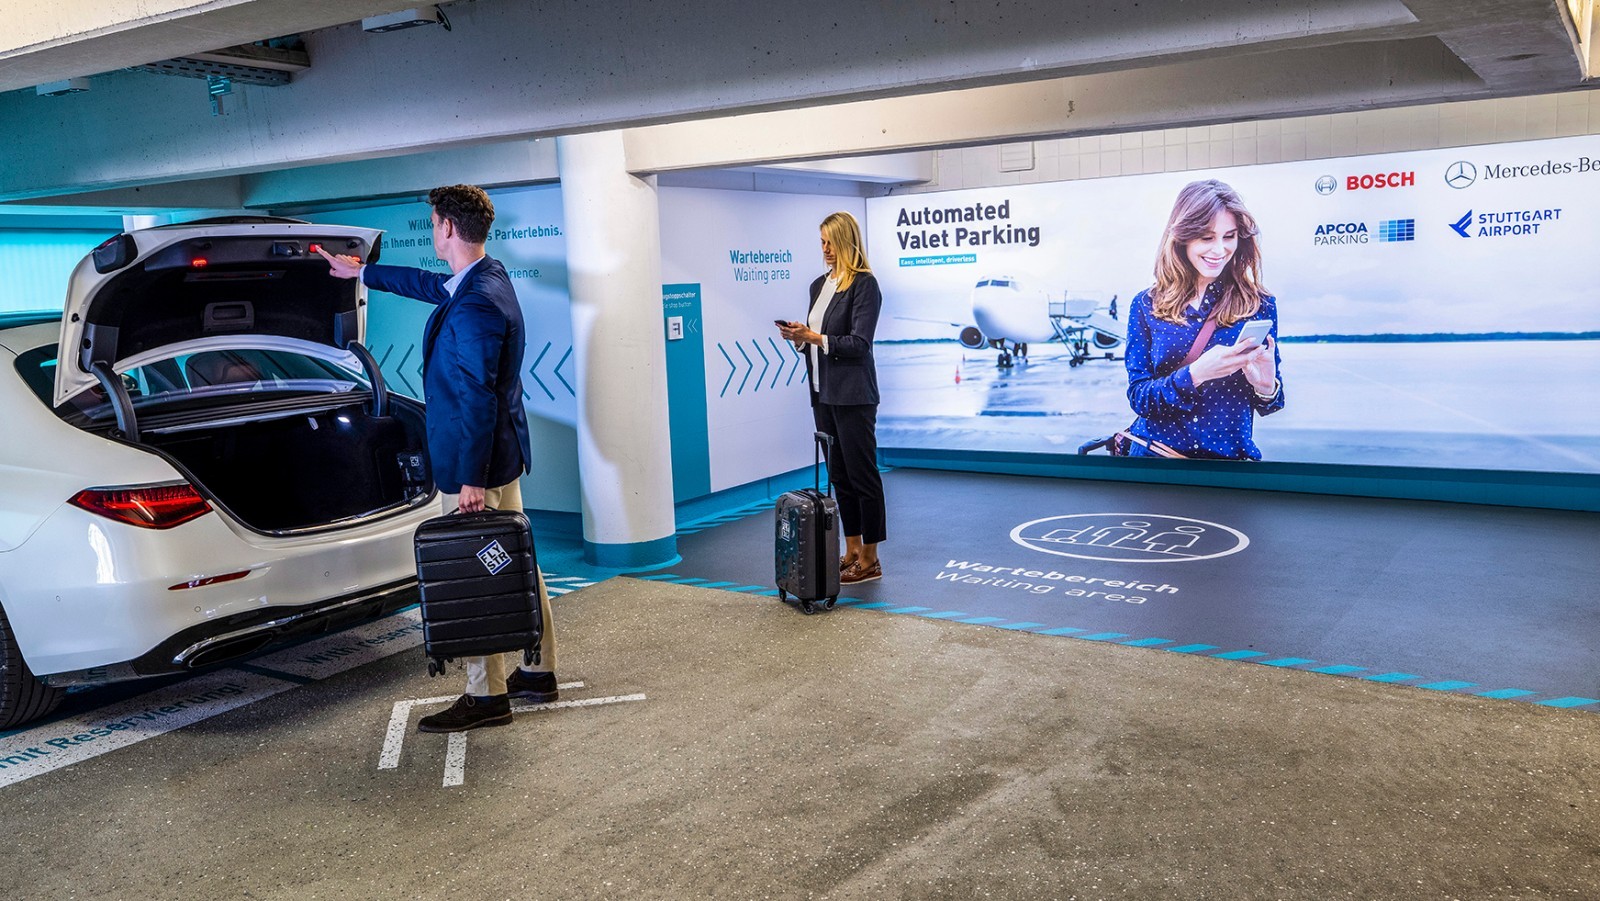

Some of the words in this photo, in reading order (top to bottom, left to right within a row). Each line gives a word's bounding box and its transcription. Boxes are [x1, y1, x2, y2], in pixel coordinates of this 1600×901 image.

[1483, 156, 1600, 180] Mercedes-Be
[1346, 171, 1415, 191] BOSCH
[896, 199, 1010, 227] Automated
[1478, 208, 1562, 224] STUTTGART
[408, 218, 434, 231] Willk
[1314, 222, 1368, 236] APCOA
[1478, 223, 1540, 238] AIRPORT
[391, 237, 415, 249] Ihnen
[417, 235, 431, 247] ein
[494, 224, 563, 241] Parkerlebnis.
[896, 230, 949, 250] Valet
[955, 223, 1040, 247] Parking
[1314, 233, 1369, 246] PARKING
[419, 256, 449, 268] Welco
[729, 249, 793, 264] Wartebereich
[509, 267, 542, 279] rience.
[734, 267, 769, 285] Waiting
[771, 269, 790, 281] area
[480, 544, 501, 564] FLY
[486, 551, 509, 570] STR
[945, 559, 1179, 594] Wartebereich
[935, 571, 1055, 594] Waiting
[1064, 588, 1147, 604] area
[45, 682, 248, 749] Reservierung!
